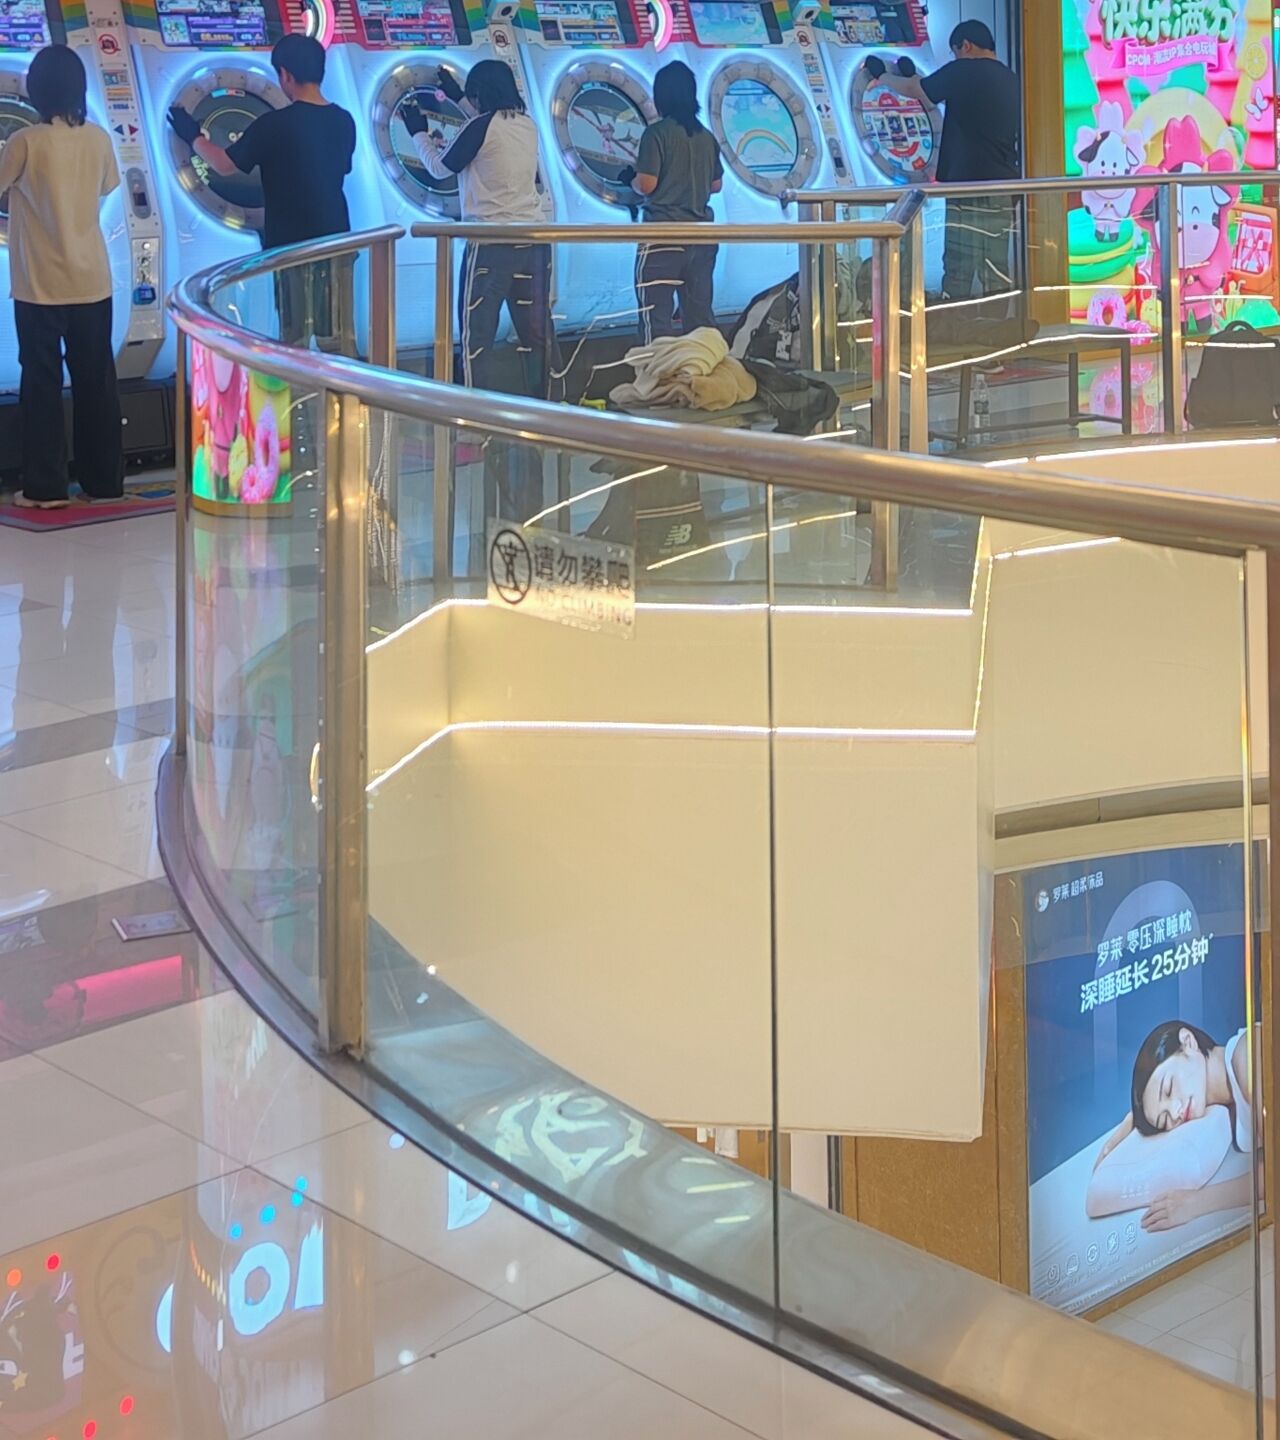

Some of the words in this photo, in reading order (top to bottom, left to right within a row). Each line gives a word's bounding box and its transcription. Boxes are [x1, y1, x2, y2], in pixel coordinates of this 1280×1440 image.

[534, 544, 631, 592] 请勿攀爬
[1053, 882, 1070, 904] 罗莱
[1097, 936, 1123, 968] 罗莱
[1127, 909, 1192, 955] 零压深睡枕
